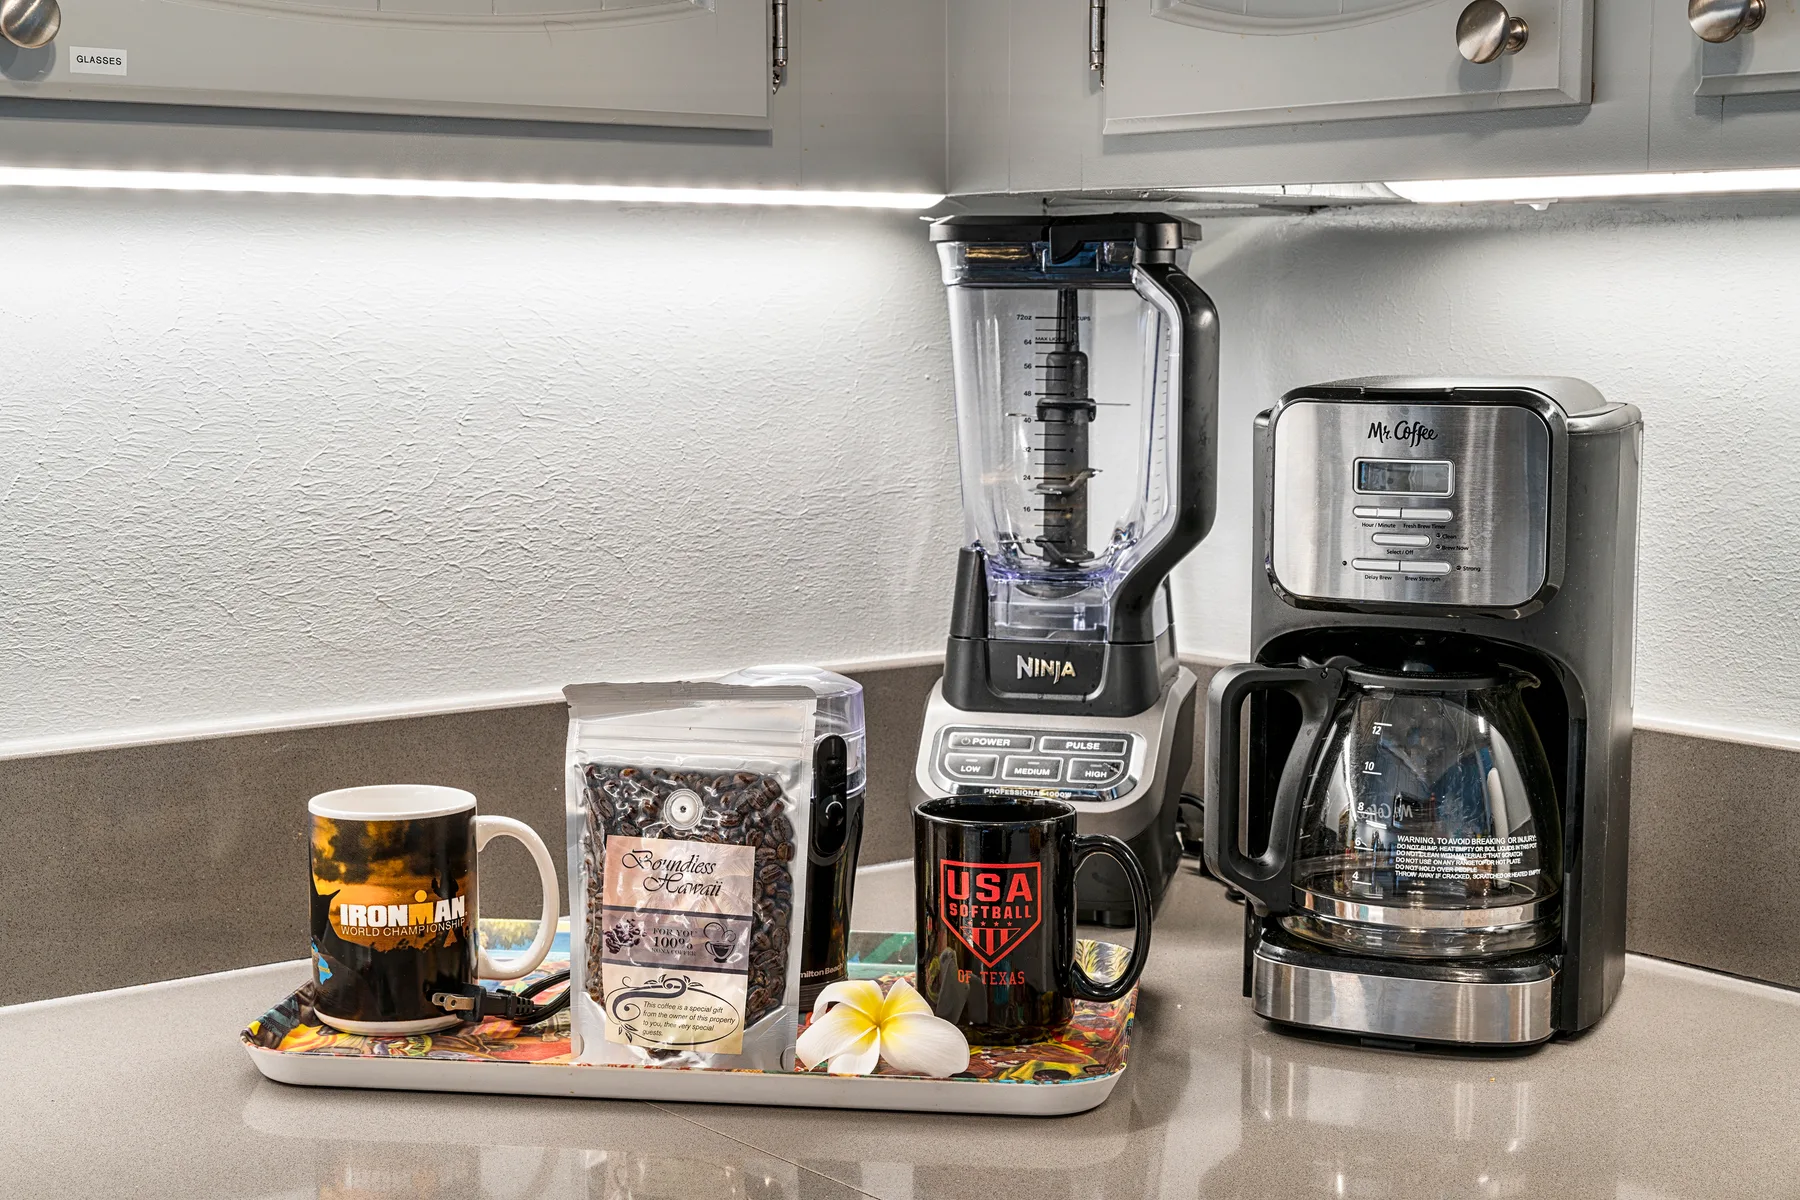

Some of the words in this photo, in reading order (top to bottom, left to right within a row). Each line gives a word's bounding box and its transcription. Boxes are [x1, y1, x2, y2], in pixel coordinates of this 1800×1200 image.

[76, 54, 122, 66] GLASSES
[1368, 421, 1392, 443] Mr.
[1394, 420, 1438, 447] Coffee
[1016, 654, 1076, 684] NINJA
[1372, 726, 1382, 735] 12
[972, 738, 1010, 746] POWER
[1066, 742, 1100, 750] PULSE
[961, 765, 981, 773] LOW
[1014, 767, 1050, 776] MEDIUM
[1364, 761, 1375, 771] 10
[1358, 802, 1364, 811] 8
[1397, 835, 1436, 845] WARNING,
[1471, 837, 1505, 845] BREAKING
[622, 849, 716, 874] Boundless
[1352, 871, 1359, 880] 4
[643, 873, 723, 896] Hawaii
[947, 869, 1033, 903] USA
[340, 890, 465, 927] IRONMAN
[949, 903, 1031, 919] SOFTBALL
[341, 926, 379, 937] WORLD
[383, 918, 465, 936] CHAMPIONSHIP
[676, 929, 697, 937] YOU
[654, 936, 693, 949] 100%
[825, 963, 843, 974] Beach
[958, 969, 973, 984] OF
[980, 971, 1025, 986] TEXAS
[657, 1002, 676, 1010] coffee
